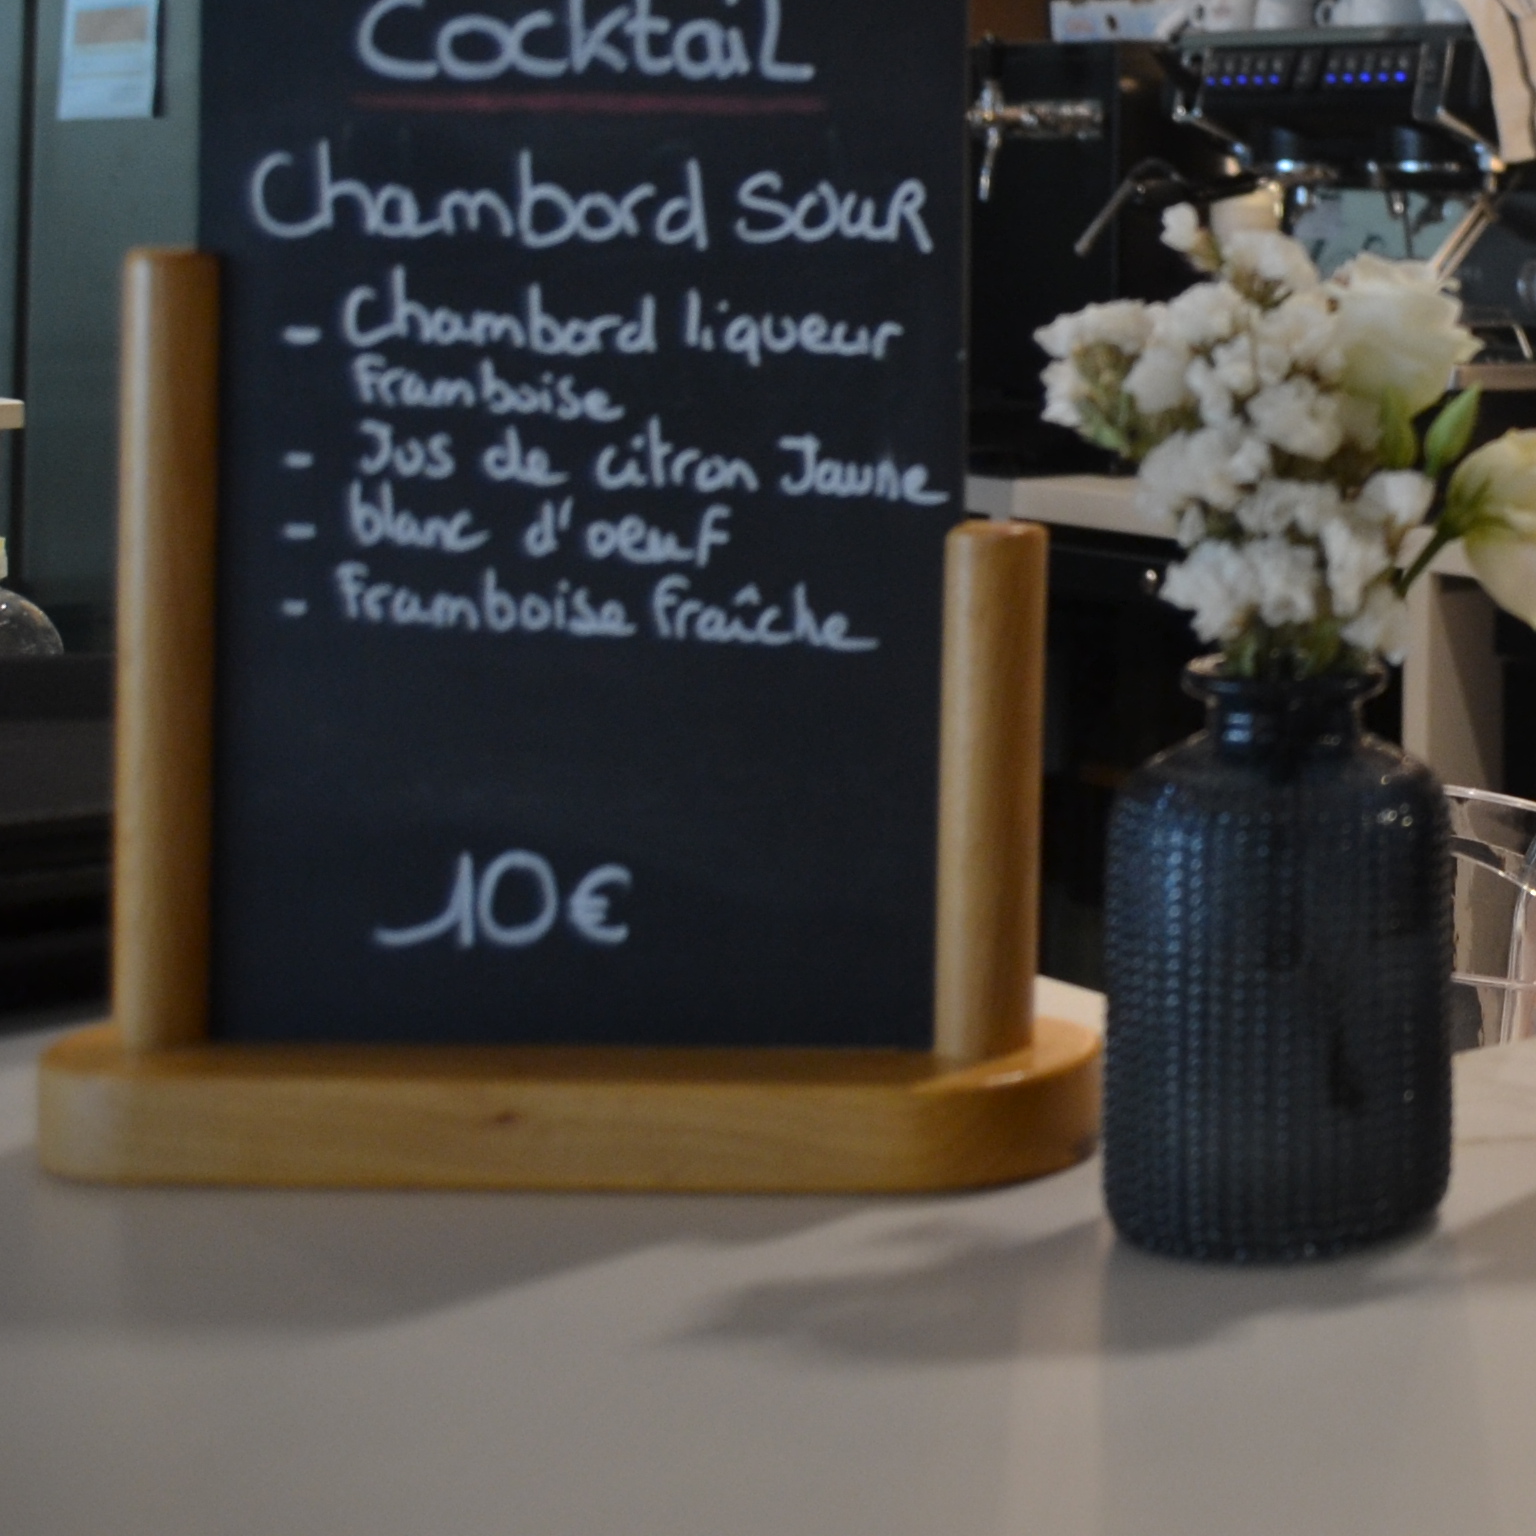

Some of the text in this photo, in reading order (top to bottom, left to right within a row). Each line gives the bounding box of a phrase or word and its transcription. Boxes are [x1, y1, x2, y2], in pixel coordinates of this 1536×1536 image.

[250, 140, 709, 250] Chambord
[342, 265, 657, 354] Chambord
[686, 289, 903, 367] liqueur
[360, 419, 455, 479] Jus
[482, 424, 567, 487] de
[594, 415, 760, 492] citron
